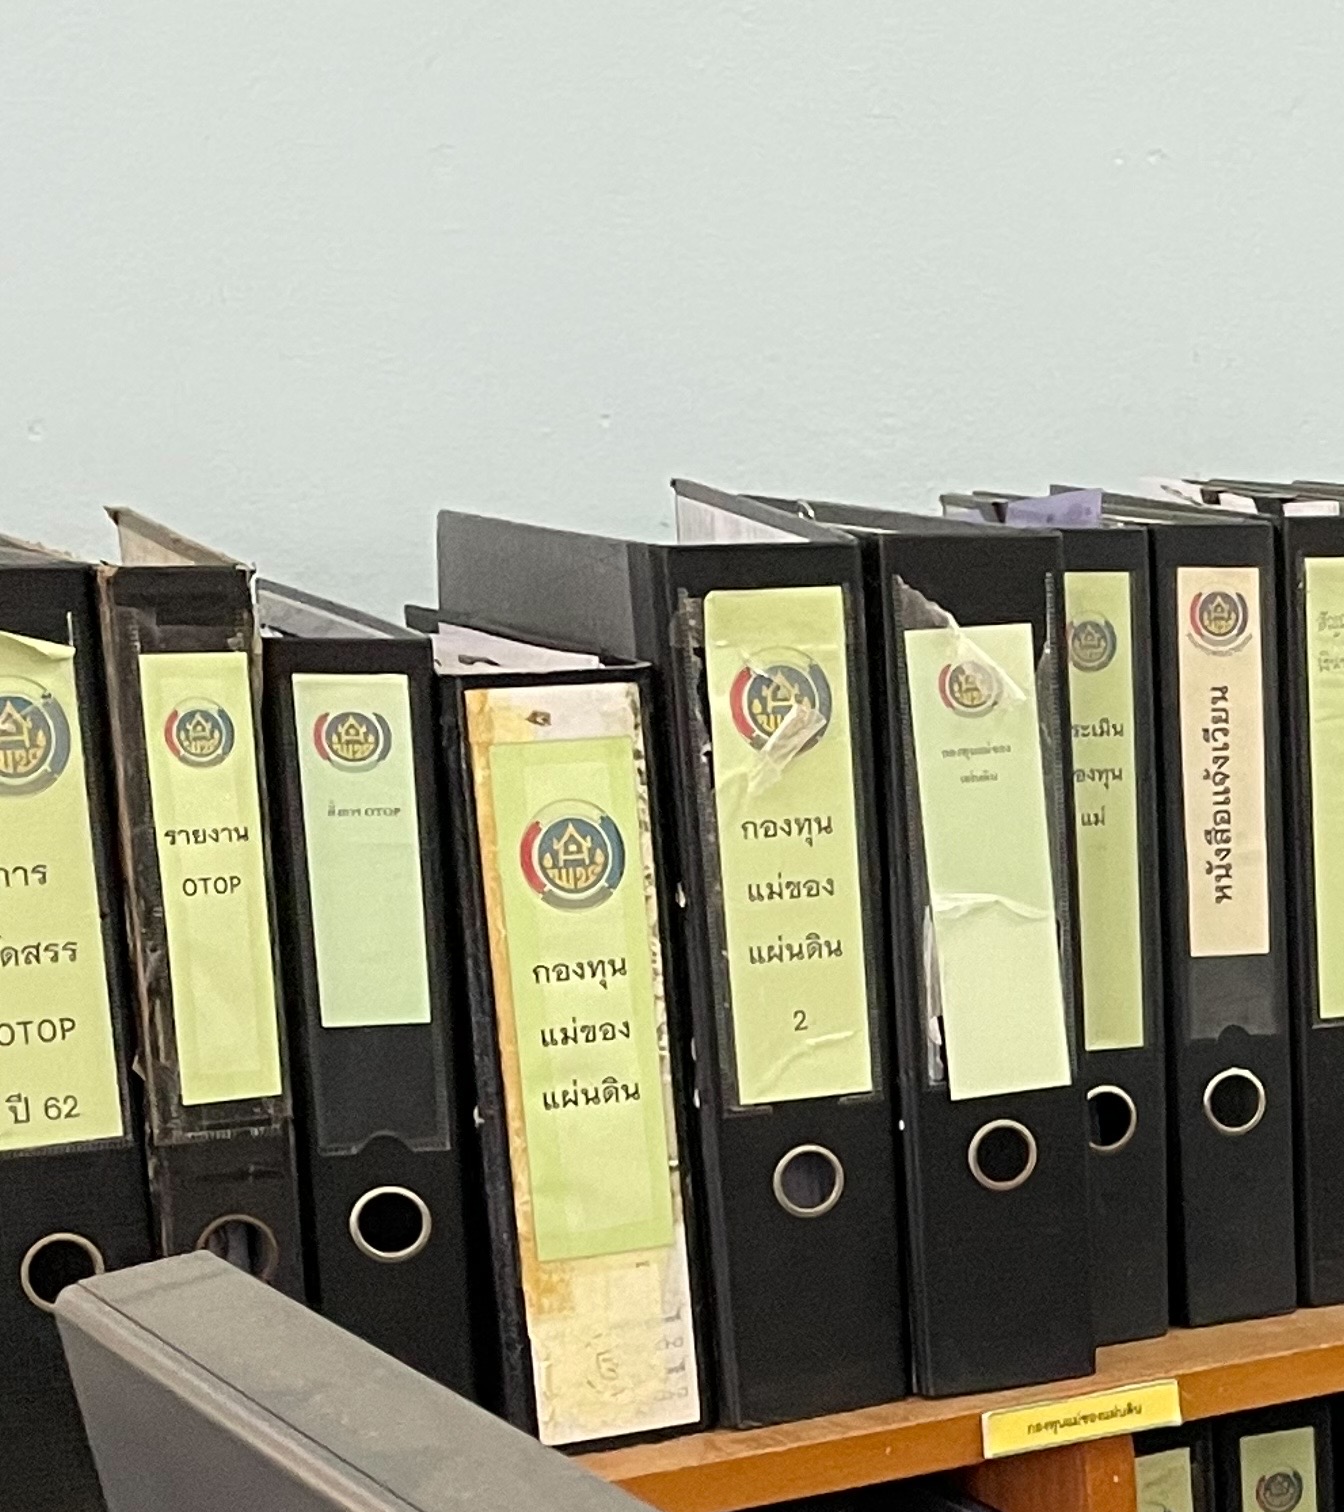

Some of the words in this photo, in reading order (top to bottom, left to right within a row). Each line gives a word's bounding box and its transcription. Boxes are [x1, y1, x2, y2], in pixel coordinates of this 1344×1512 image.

[1072, 717, 1124, 738] ระเมิน
[1073, 766, 1123, 790] องทุน
[1202, 684, 1233, 905] หนังสือแจ้งเวียน
[741, 814, 833, 848] กองทุน
[1080, 805, 1105, 827] แม่
[164, 825, 250, 846] รายงาน
[182, 875, 241, 897] OTOP
[747, 872, 836, 903] แม่ของ
[0, 938, 78, 967] ดสรร
[748, 932, 844, 965] แผ่นดิน
[532, 956, 627, 989] กองทุน
[541, 1016, 631, 1048] แม่ของ
[793, 1010, 809, 1032] 2
[542, 1075, 641, 1111] แผ่นดิน
[8, 1093, 31, 1125] ปี
[44, 1095, 80, 1121] 62
